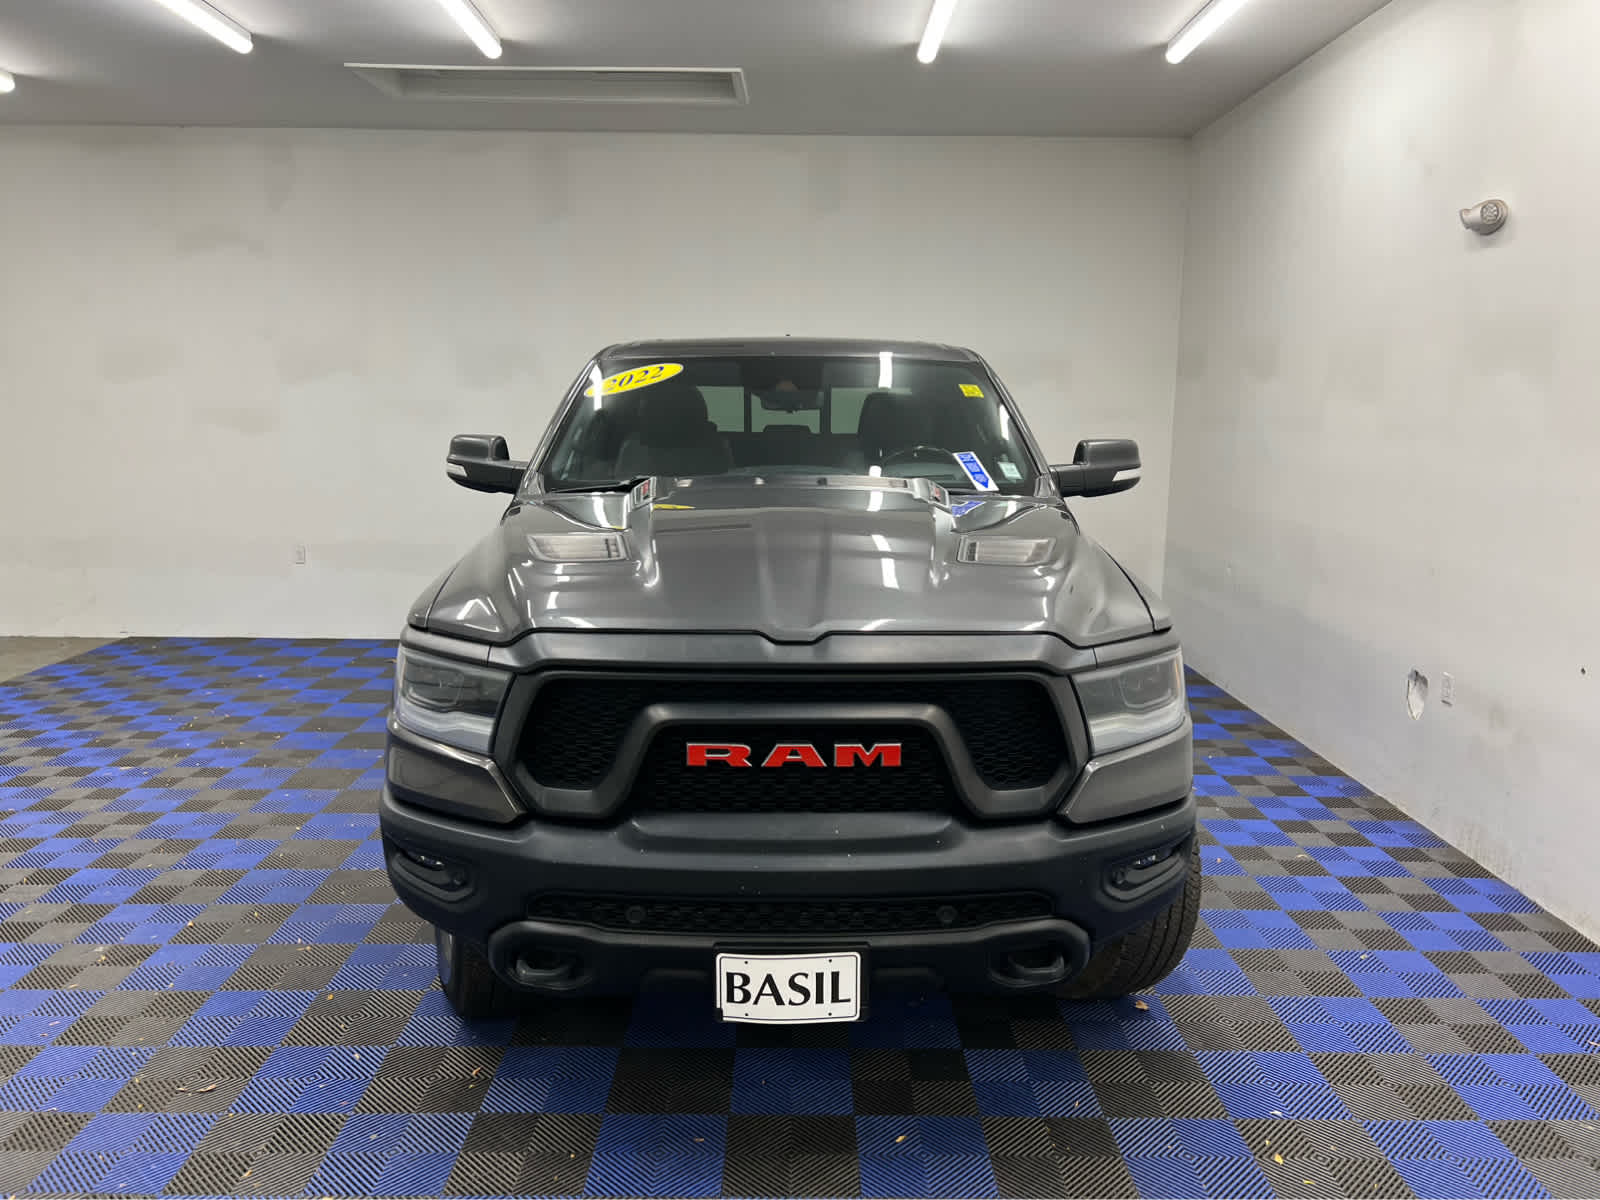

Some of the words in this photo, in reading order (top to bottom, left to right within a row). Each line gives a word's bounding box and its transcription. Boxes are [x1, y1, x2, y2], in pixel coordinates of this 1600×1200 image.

[607, 366, 665, 391] 2022
[686, 742, 902, 768] RAM
[726, 971, 851, 1006] BASIL
